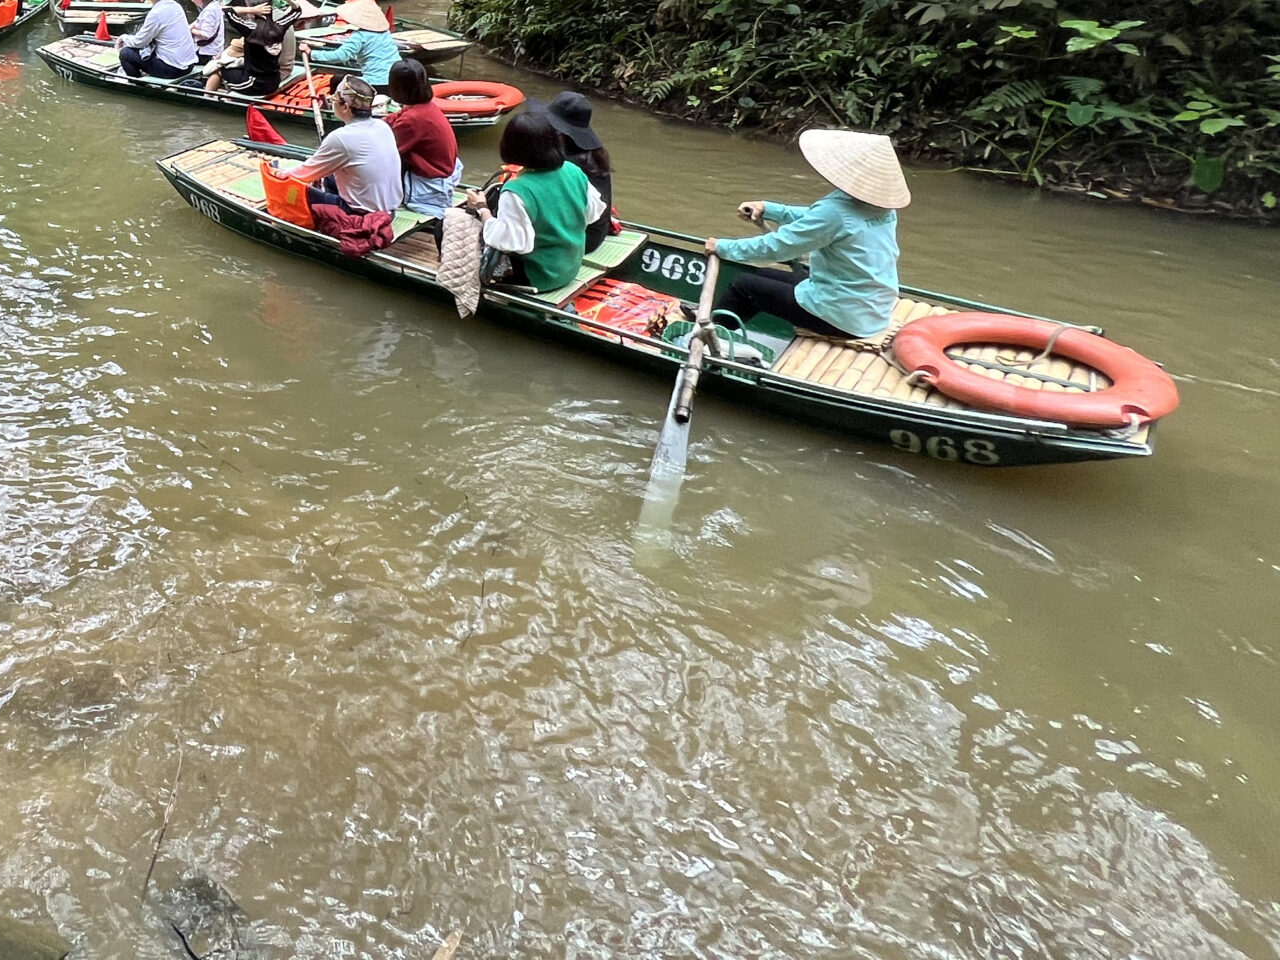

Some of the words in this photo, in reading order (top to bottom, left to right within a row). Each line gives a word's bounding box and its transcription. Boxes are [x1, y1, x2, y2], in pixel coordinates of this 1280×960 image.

[190, 193, 221, 222] 968
[641, 248, 706, 286] 968
[889, 429, 1000, 465] 968
